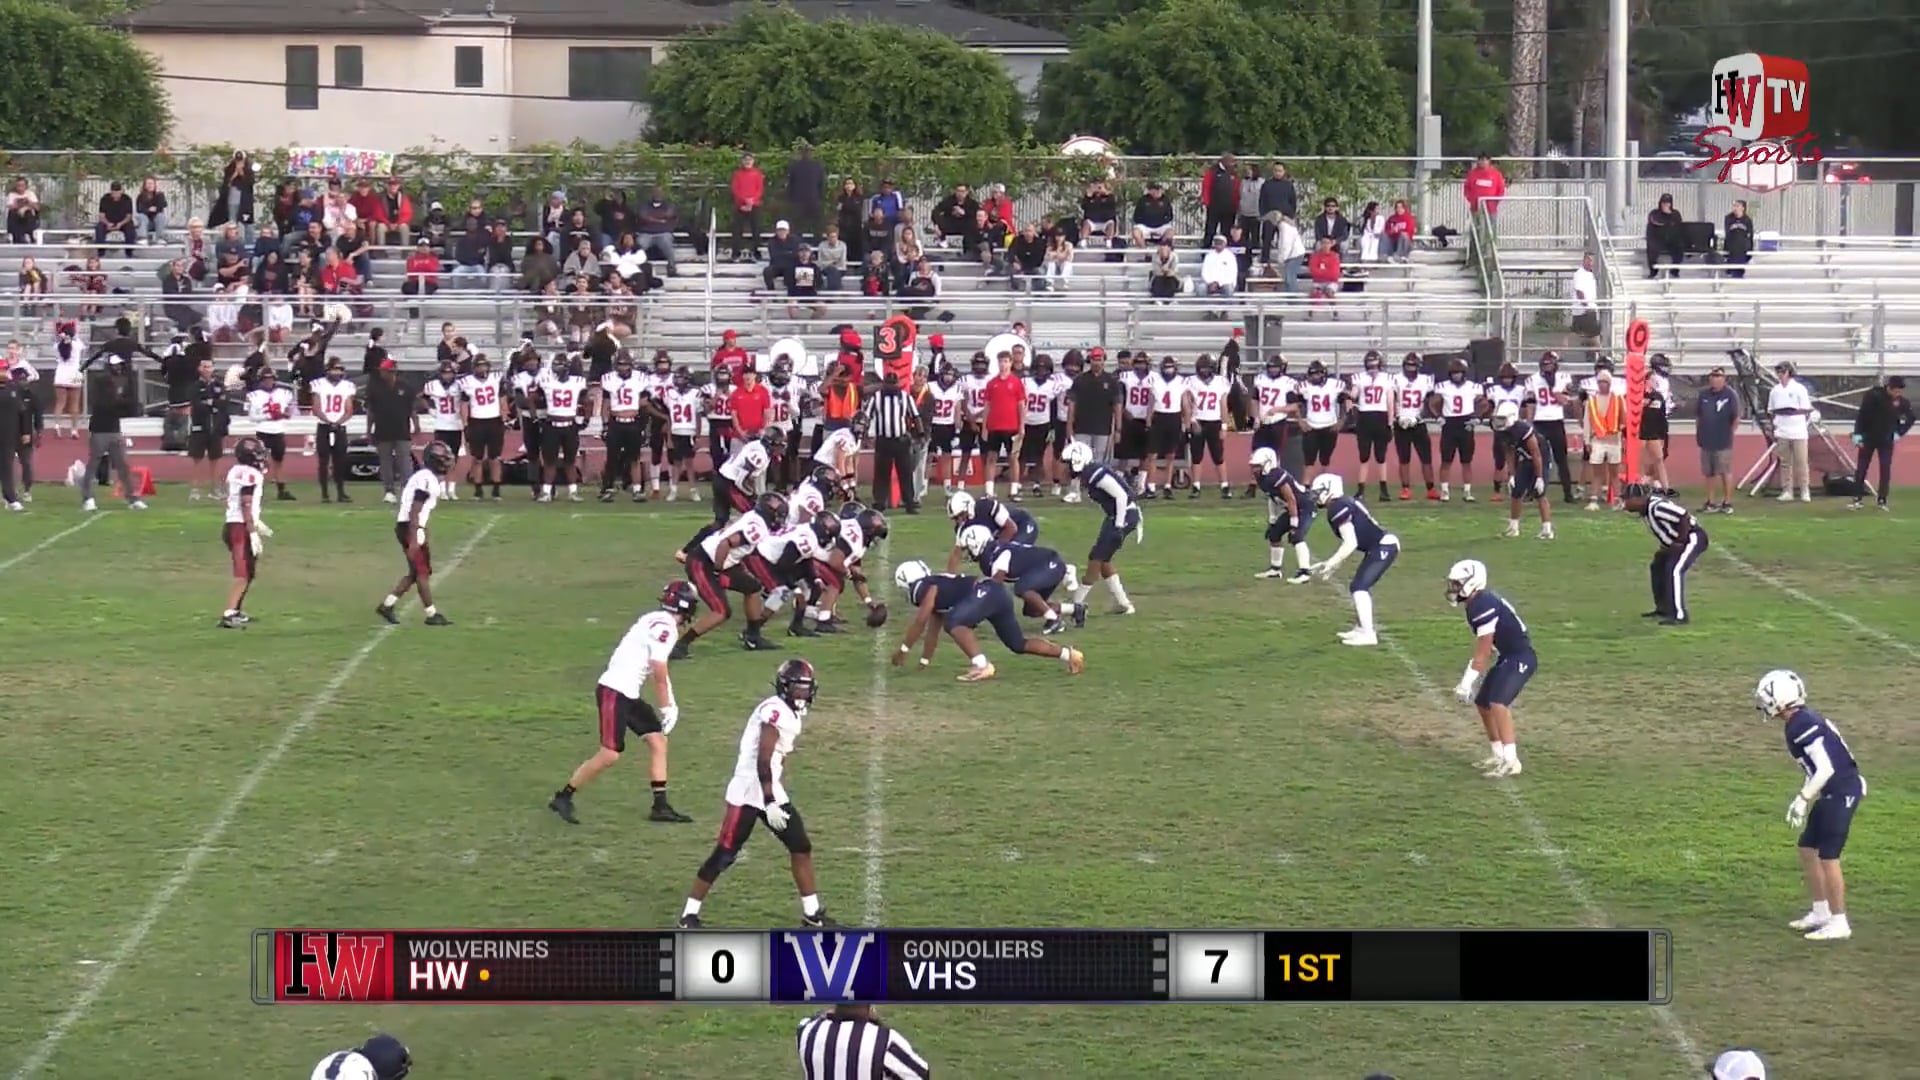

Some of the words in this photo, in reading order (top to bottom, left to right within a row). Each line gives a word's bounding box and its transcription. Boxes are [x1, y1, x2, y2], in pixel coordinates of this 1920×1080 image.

[878, 327, 897, 353] 3
[325, 394, 343, 413] 18
[475, 386, 495, 406] 62
[617, 388, 633, 405] 15
[1028, 394, 1047, 412] 25
[1130, 387, 1150, 406] 68
[1162, 391, 1171, 409] 4
[1198, 392, 1217, 410] 72
[1261, 387, 1281, 406] 57
[1312, 394, 1330, 412] 64
[1364, 386, 1384, 404] 50
[1402, 390, 1422, 408] 53
[440, 397, 456, 414] 21
[673, 404, 692, 422] 24
[936, 400, 953, 417] 22
[1453, 396, 1463, 414] 9
[659, 630, 669, 643] 2
[769, 710, 780, 723] 3
